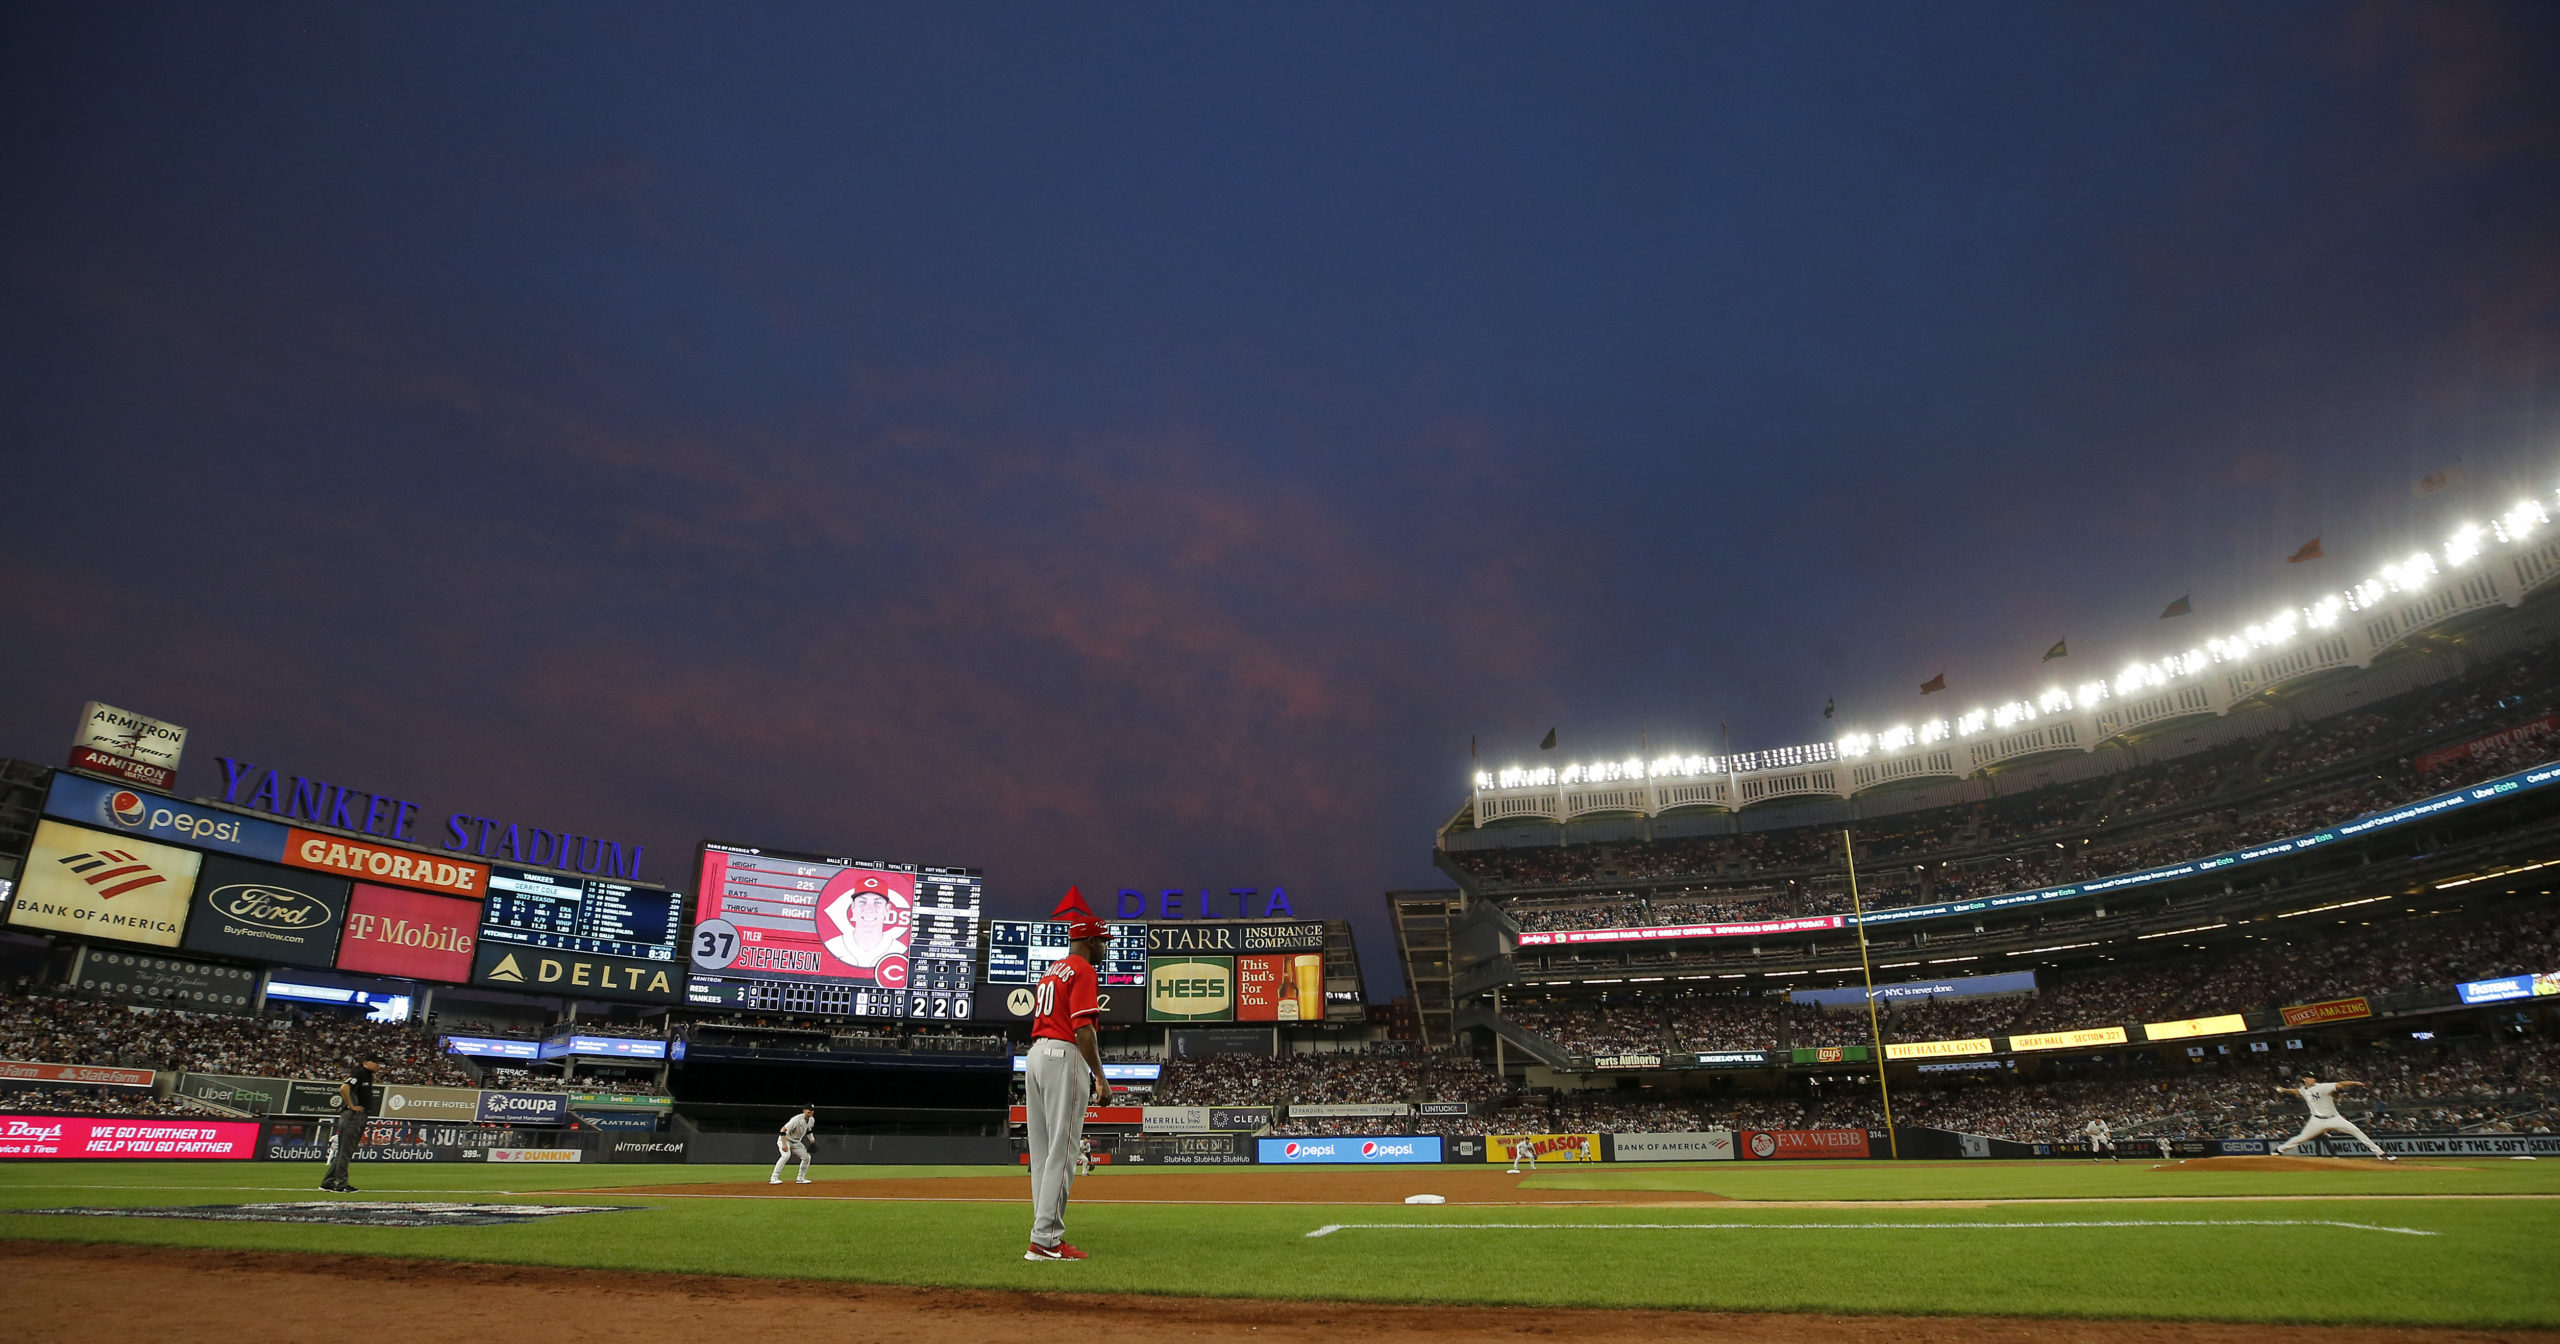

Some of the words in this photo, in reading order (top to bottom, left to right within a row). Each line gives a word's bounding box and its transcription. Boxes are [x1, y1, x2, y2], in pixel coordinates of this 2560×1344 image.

[93, 710, 181, 742] ARMITRON
[86, 752, 167, 780] ARMITRON
[124, 771, 163, 785] WATCHES
[2472, 787, 2495, 799] Uber
[2493, 781, 2518, 793] Eats
[2526, 772, 2551, 783] Order
[216, 757, 420, 842] YANKEE
[444, 812, 644, 881] STADIUM
[149, 808, 240, 844] pepsi
[2200, 861, 2217, 870] Uber
[2217, 857, 2234, 866] Eats
[2296, 839, 2316, 847] Uber
[2315, 833, 2333, 842] Eats
[300, 838, 477, 890] GATORADE
[732, 861, 757, 869] HEIGHT
[797, 867, 817, 876] 6'4"
[523, 873, 554, 884] YANKEES
[730, 875, 758, 884] WEIGHT
[796, 880, 815, 890] 225
[532, 895, 556, 904] SEASON
[728, 889, 748, 897] BATS
[783, 894, 813, 904] RIGHT
[229, 887, 311, 926] Ford
[727, 904, 759, 913] THROWS
[1117, 886, 1295, 919] DELTA
[1970, 902, 1986, 910] Eats
[16, 899, 67, 917] BANK
[73, 909, 97, 922] OF
[99, 913, 178, 934] AMERICA
[781, 908, 811, 919] RIGHT
[349, 913, 375, 940] T
[380, 916, 472, 954] Mobile
[1245, 924, 1323, 938] INSURANCE
[1715, 925, 1761, 934] DOWNLOAD
[1797, 920, 1827, 929] TODAY.
[223, 924, 304, 944] BuyFordNow.com
[743, 930, 762, 942] TYLER
[996, 931, 1004, 941] 2
[1019, 931, 1025, 941] 1
[1148, 928, 1237, 950] STARR
[697, 931, 735, 959] 37
[1245, 936, 1323, 949] COMPANIES
[648, 949, 672, 960] 8:30
[739, 946, 822, 973] STEPHENSON
[1240, 959, 1269, 971] This
[538, 959, 671, 993] DELTA
[692, 975, 722, 983] ARMITRON
[1240, 970, 1275, 983] Bud's
[689, 985, 709, 993] REDS
[1155, 979, 1226, 998] HESS
[1240, 983, 1262, 994] For
[1884, 987, 1903, 997] NYC
[1904, 987, 1912, 995] is
[1912, 987, 1932, 995] never
[1932, 984, 1954, 994] done.
[689, 995, 722, 1003] YANKEES
[737, 991, 744, 1000] 2
[1034, 981, 1055, 1017] 90
[1240, 994, 1269, 1006] You.
[912, 998, 926, 1017] 2
[933, 998, 947, 1017] 2
[955, 999, 968, 1018] 0
[2320, 1003, 2366, 1017] AMAZING
[2019, 1038, 2041, 1047] GREAT
[2044, 1036, 2063, 1045] HALL
[2074, 1032, 2104, 1042] SECTION
[2106, 1031, 2120, 1040] 321
[1818, 1049, 1841, 1061] Lay's
[1891, 1046, 1913, 1056] THE
[1915, 1044, 1954, 1054] HALAL
[1956, 1041, 1986, 1052] GUYS
[1595, 1057, 1619, 1066] Parts
[1619, 1055, 1661, 1066] Authority
[1700, 1055, 1743, 1063] BIGELOW
[78, 1068, 139, 1083] StateFarm
[496, 1067, 528, 1077] TERRACE
[198, 1086, 233, 1101] Uber
[235, 1088, 270, 1102] Eats
[408, 1099, 440, 1108] LOTTE
[441, 1101, 475, 1109] HOTELS
[509, 1096, 557, 1114] coupa
[1233, 1115, 1267, 1124] CLEAR
[8, 1121, 62, 1142] Boys
[91, 1126, 114, 1138] WE
[115, 1127, 136, 1139] GO
[137, 1128, 197, 1140] FURTHER
[200, 1129, 216, 1140] TO
[1180, 1139, 1230, 1151] VIKING
[1776, 1133, 1807, 1147] F.W.
[1810, 1132, 1861, 1146] WEBB
[2407, 1140, 2414, 1151] A
[2416, 1139, 2445, 1151] VIEW
[2449, 1139, 2464, 1151] OF
[2465, 1139, 2491, 1151] THE
[2494, 1139, 2525, 1151] SOFT
[22, 1145, 30, 1153] &
[33, 1145, 58, 1153] Tires
[85, 1140, 124, 1152] HELP
[126, 1141, 154, 1152] YOU
[155, 1142, 175, 1152] GO
[176, 1142, 232, 1153] FARTHER
[614, 1142, 684, 1153] NITTOTIRE.COM
[1302, 1144, 1335, 1157] pepsi
[1379, 1143, 1414, 1156] pepsi
[1618, 1143, 1644, 1151] BANK
[1662, 1142, 1707, 1151] AMERICA
[2222, 1142, 2263, 1151] GEICO
[270, 1146, 322, 1160] StubHub
[382, 1147, 433, 1161] StubHub
[462, 1150, 478, 1158] 399
[524, 1151, 575, 1161] DUNKIN'
[1164, 1155, 1192, 1163] StubHub
[1193, 1155, 1221, 1163] StubHub
[1222, 1155, 1250, 1163] StubHub
